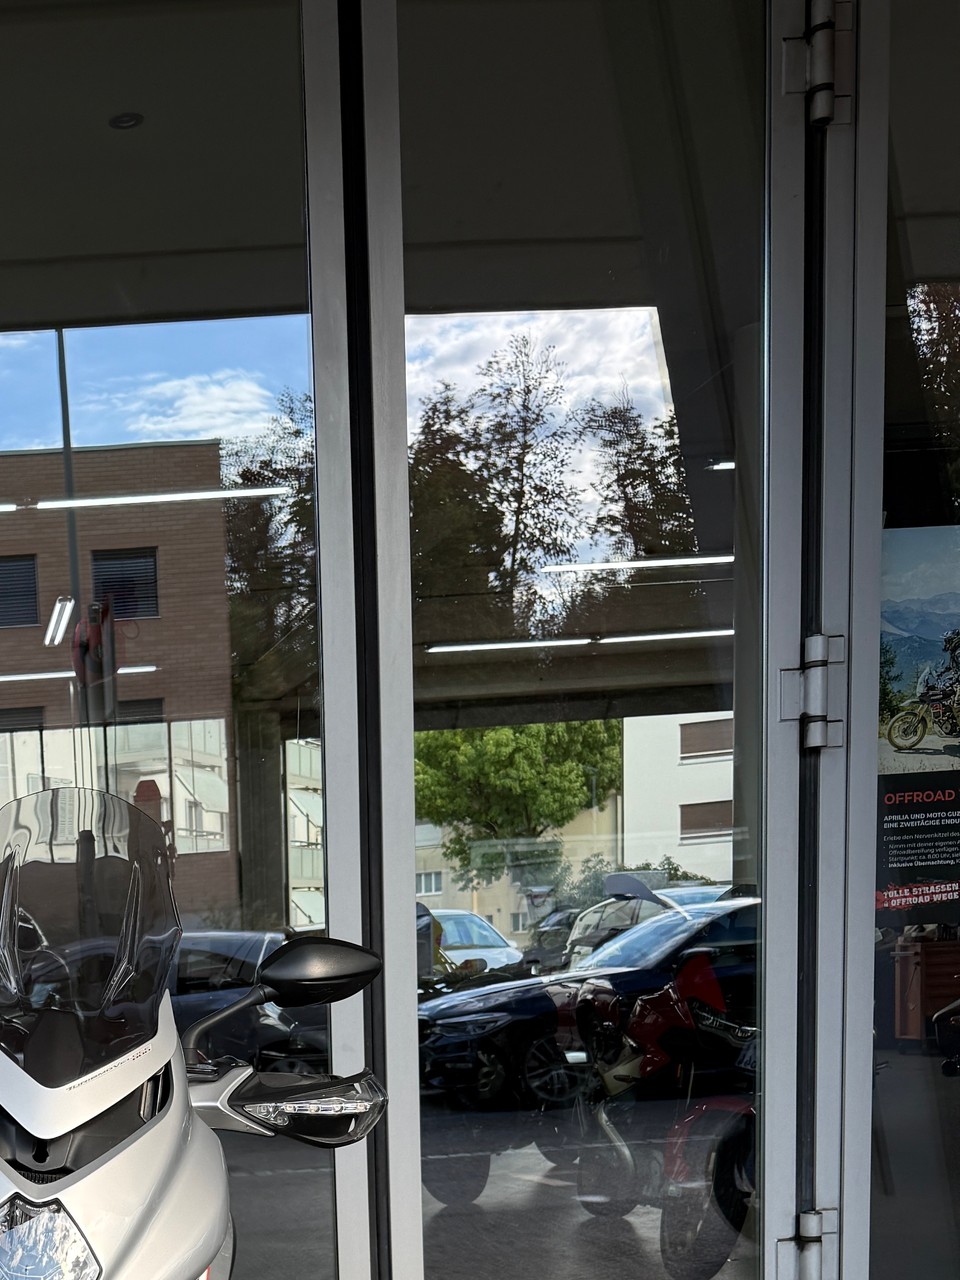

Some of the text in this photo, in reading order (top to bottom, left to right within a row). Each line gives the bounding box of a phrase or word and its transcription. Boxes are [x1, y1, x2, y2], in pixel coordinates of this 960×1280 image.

[884, 789, 955, 805] OFFROAD
[883, 814, 909, 822] APRILIA
[926, 811, 946, 819] MOTO
[900, 819, 940, 828] ZWEITÄGIGE
[883, 883, 959, 899] TOLLE STRASSEN
[891, 895, 930, 906] OFFROAD
[933, 892, 959, 901] WEGE
